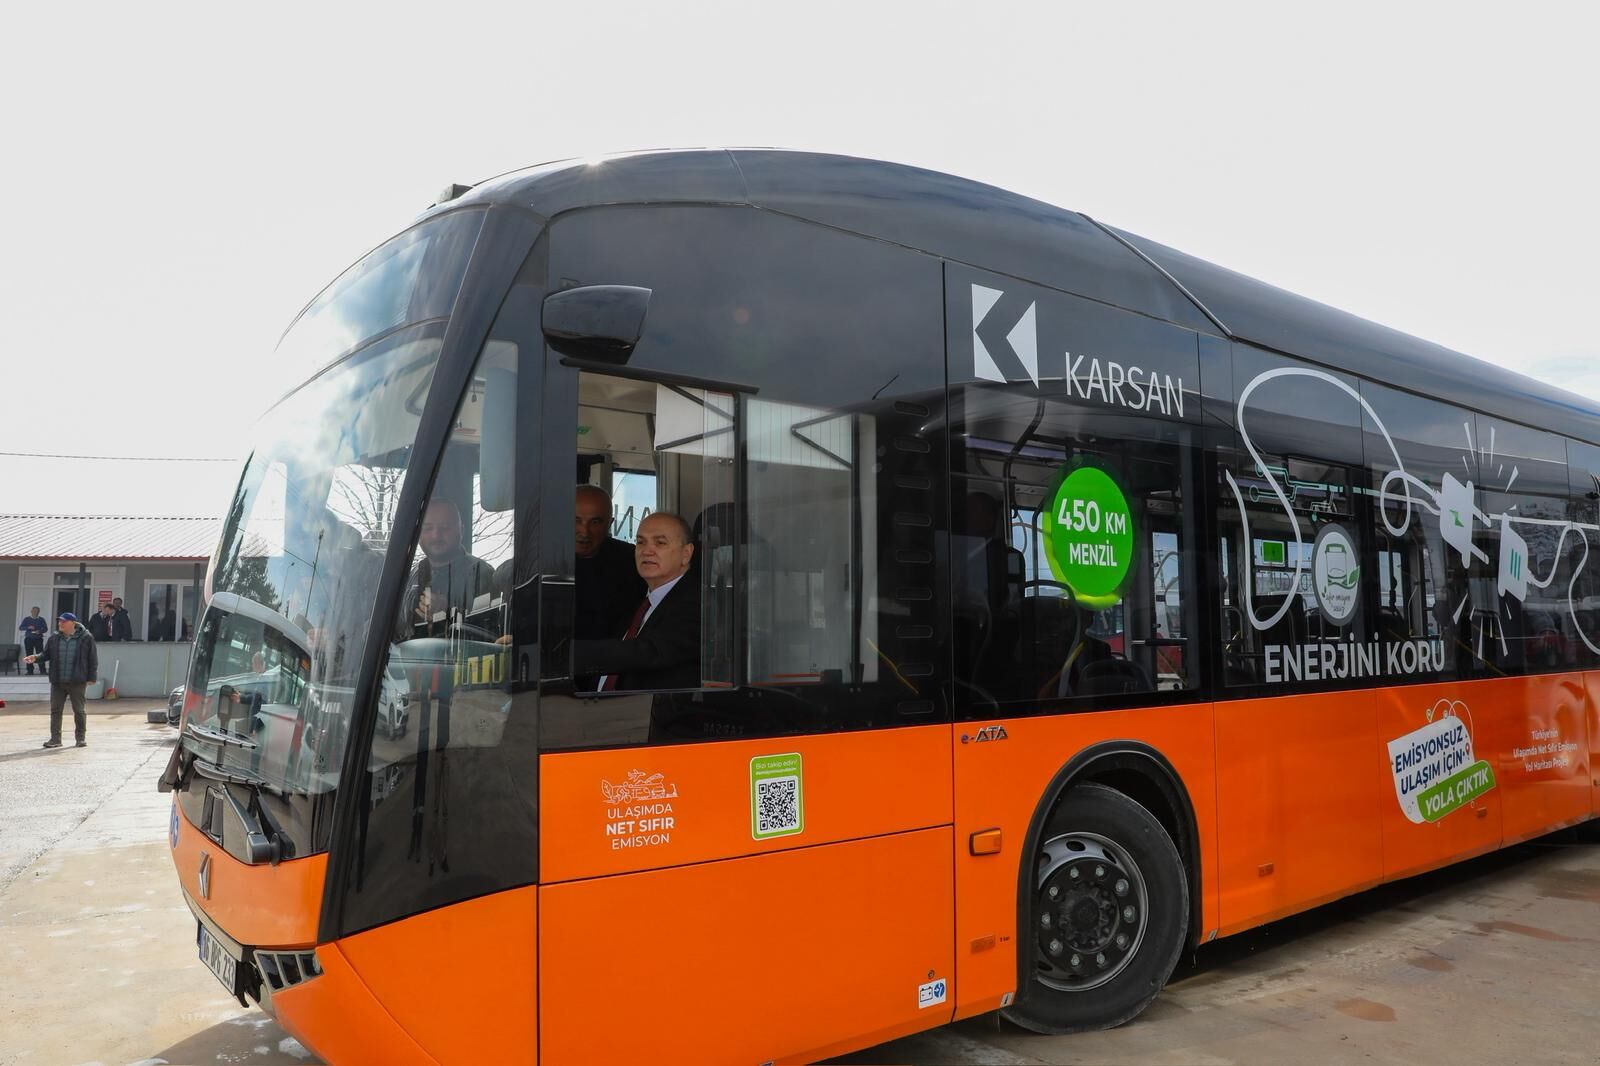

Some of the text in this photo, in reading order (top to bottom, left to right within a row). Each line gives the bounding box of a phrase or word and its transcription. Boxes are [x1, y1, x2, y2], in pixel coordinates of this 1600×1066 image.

[1065, 351, 1184, 418] KARSAN
[1057, 498, 1126, 535] 450 KM
[1069, 540, 1118, 567] MENZİL
[1264, 631, 1445, 683] ENERJİNİ KORU
[1395, 725, 1464, 774] EMİSYONSUZ
[1401, 747, 1463, 796] ULAŞIM İÇİN
[1425, 767, 1489, 816] YOLA ÇIKTIK
[606, 816, 674, 836] NET SIFIR
[607, 803, 673, 820] ULAŞIMDA
[612, 832, 670, 850] EMİSYON
